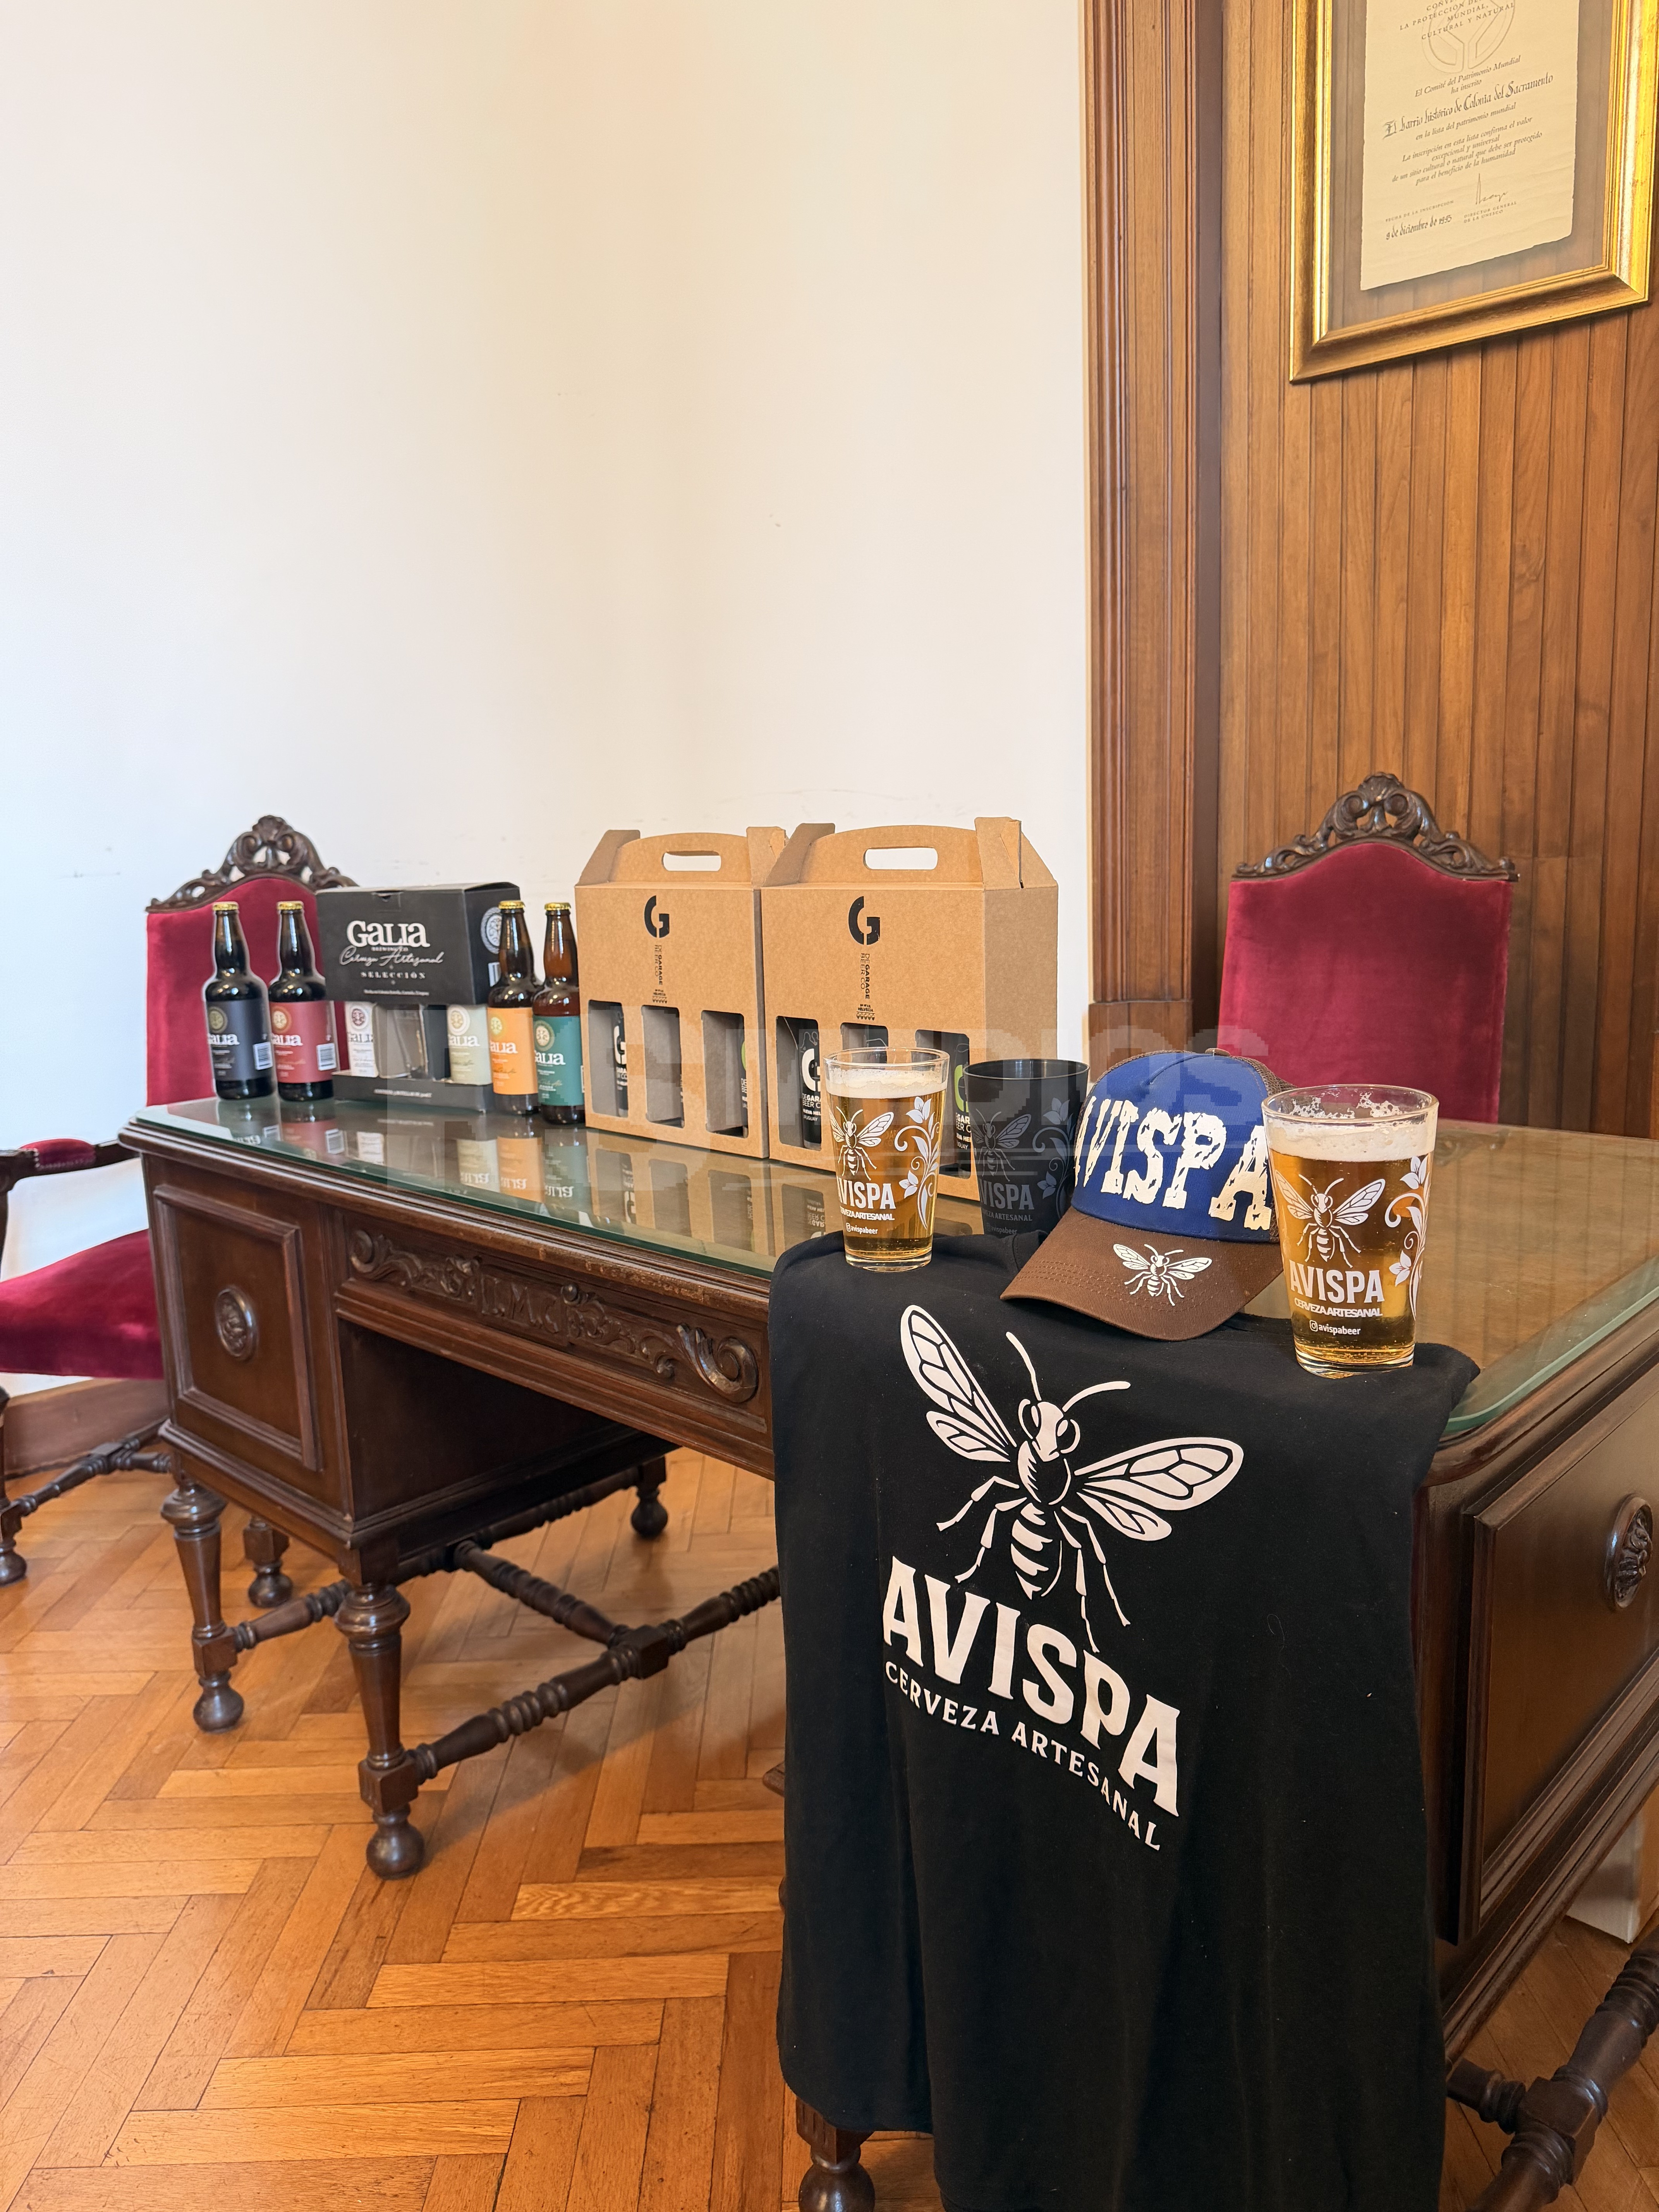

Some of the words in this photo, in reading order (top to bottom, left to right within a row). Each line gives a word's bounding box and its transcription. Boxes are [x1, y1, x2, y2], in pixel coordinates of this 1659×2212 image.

[1422, 21, 1463, 40] CULTURAL
[1476, 3, 1514, 21] NATURAL
[1447, 3, 1488, 21] MUNDIAL,
[1415, 88, 1422, 97] El
[1424, 81, 1446, 94] Comité
[1448, 77, 1456, 86] del
[1458, 67, 1491, 84] Patrimonio
[1493, 55, 1521, 71] Mundial
[1460, 79, 1482, 91] inscrito
[1400, 116, 1422, 132] barrio
[1454, 97, 1462, 113] de
[1463, 93, 1492, 111] Colonia
[1494, 84, 1505, 100] del
[1505, 71, 1554, 98] Sacramento
[1425, 129, 1430, 137] la
[1432, 125, 1444, 135] lista
[1446, 122, 1455, 131] del
[1456, 112, 1489, 130] patrimonio
[1491, 102, 1516, 116] mundial
[1402, 153, 1411, 162] La
[1453, 137, 1465, 146] esta
[1467, 132, 1479, 142] lista
[1480, 125, 1507, 138] confirma
[1516, 116, 1533, 126] valor
[1410, 167, 1421, 177] sitio
[1422, 160, 1445, 173] cultural
[1452, 152, 1474, 164] natural
[1475, 149, 1487, 159] que
[1488, 144, 1502, 153] debe
[1514, 131, 1542, 147] protegido
[1431, 146, 1465, 161] excepcional
[1472, 134, 1500, 149] universal
[1416, 176, 1429, 186] para
[1438, 164, 1463, 178] beneficio
[1465, 161, 1472, 169] de
[1473, 158, 1479, 167] la
[1481, 148, 1516, 164] humanidad
[995, 1212, 1032, 1221] ARTESANAL
[1289, 1259, 1385, 1303] AVISPA
[883, 1556, 1180, 1817] AVISPA
[885, 1661, 1000, 1736] CERVEZA
[1011, 1721, 1160, 1851] ARTESANAL
